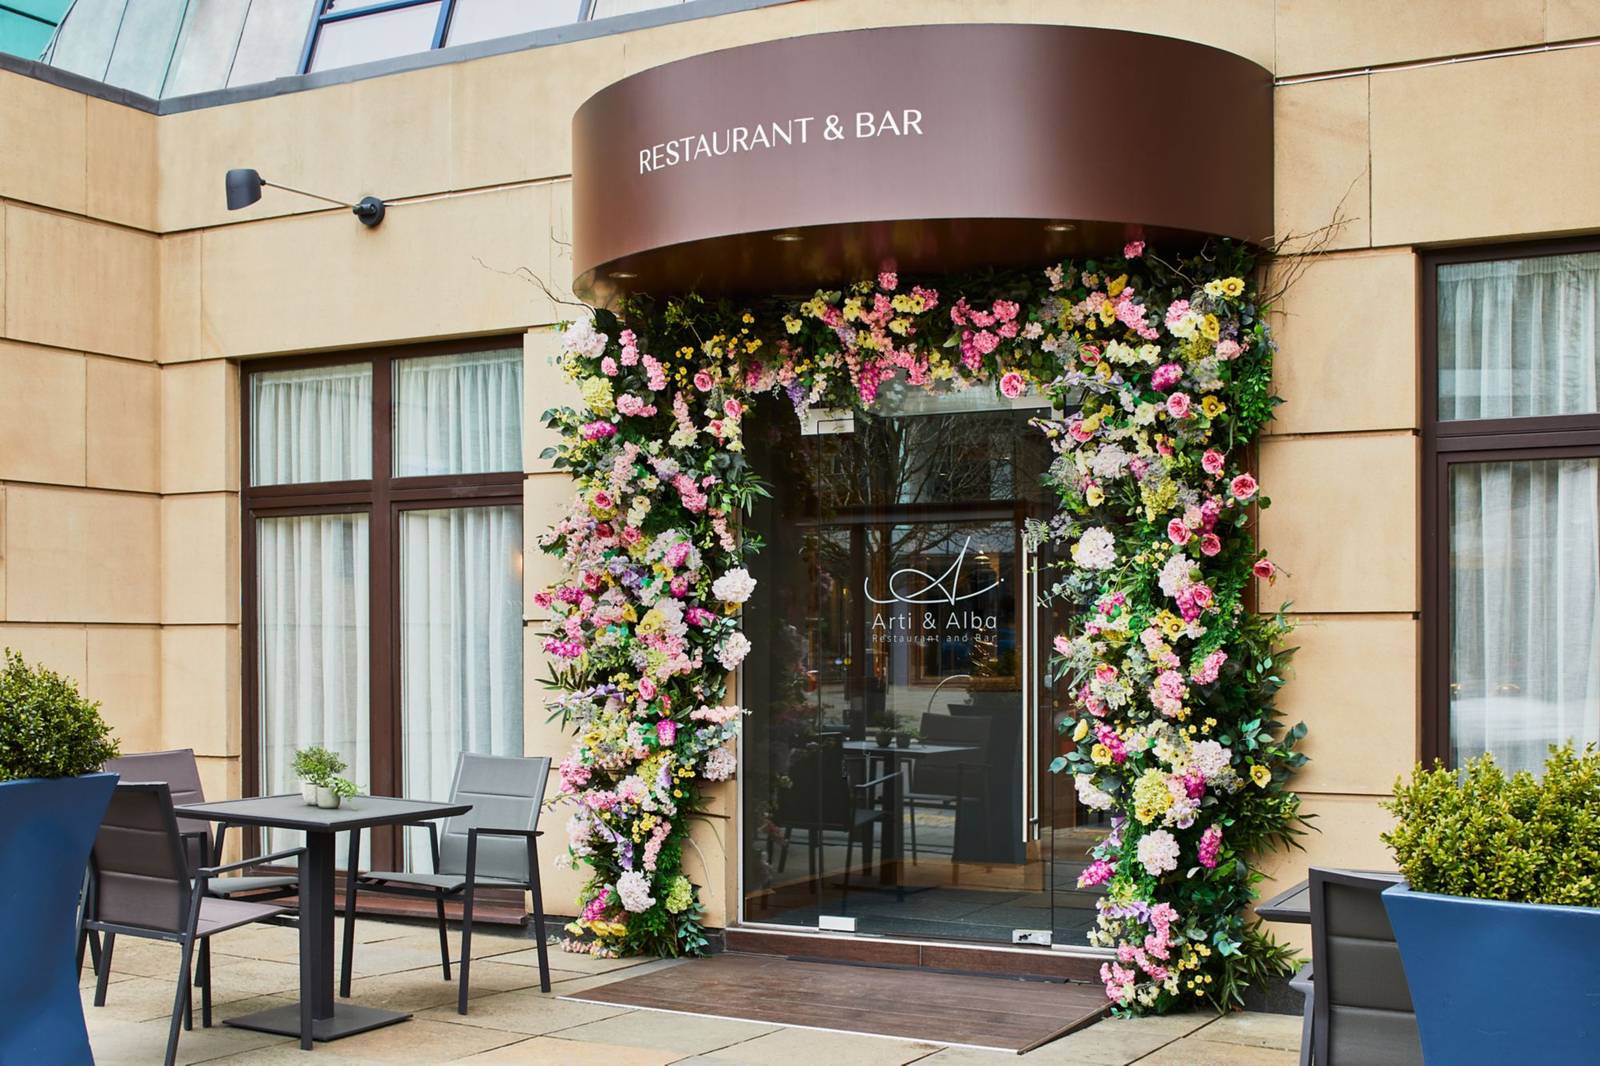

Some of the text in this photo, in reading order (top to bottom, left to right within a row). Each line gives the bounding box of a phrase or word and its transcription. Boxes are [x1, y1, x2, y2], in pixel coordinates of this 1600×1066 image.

[639, 109, 923, 174] RESTAURANT & BAR
[872, 611, 997, 630] Arti & Alba
[872, 633, 998, 643] Restaurant and Bar
